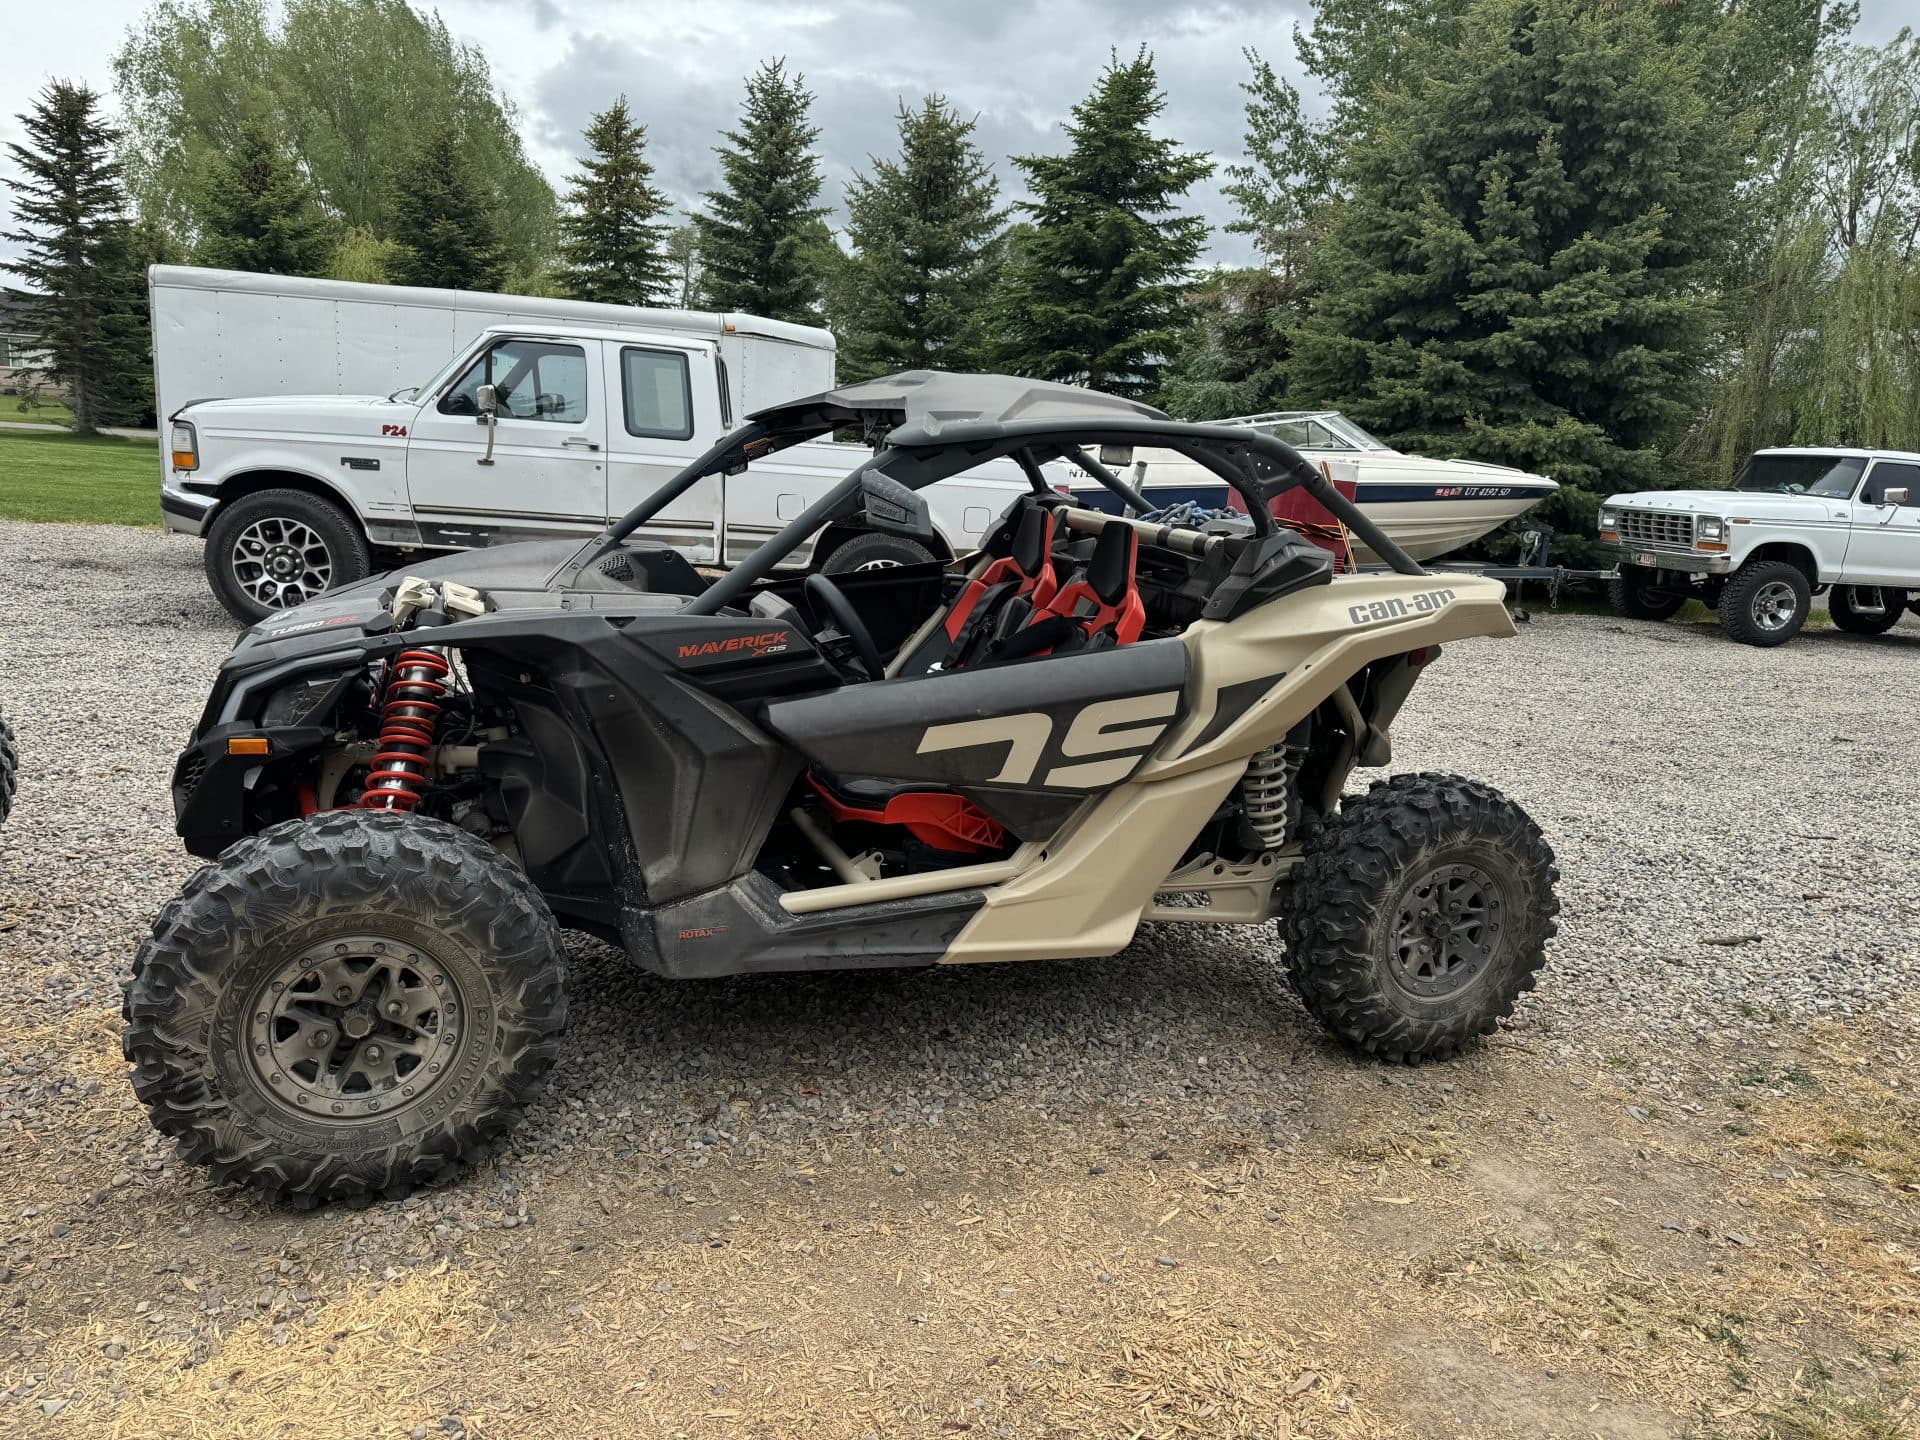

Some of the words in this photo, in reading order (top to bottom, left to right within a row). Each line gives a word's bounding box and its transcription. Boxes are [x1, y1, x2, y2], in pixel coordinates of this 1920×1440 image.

[1464, 487, 1480, 496] UT
[1348, 588, 1457, 625] can-am
[271, 620, 325, 637] TURBO
[679, 631, 790, 659] MAVERICK
[679, 926, 713, 939] ROTAX
[422, 1008, 489, 1121] CARNIVORE
